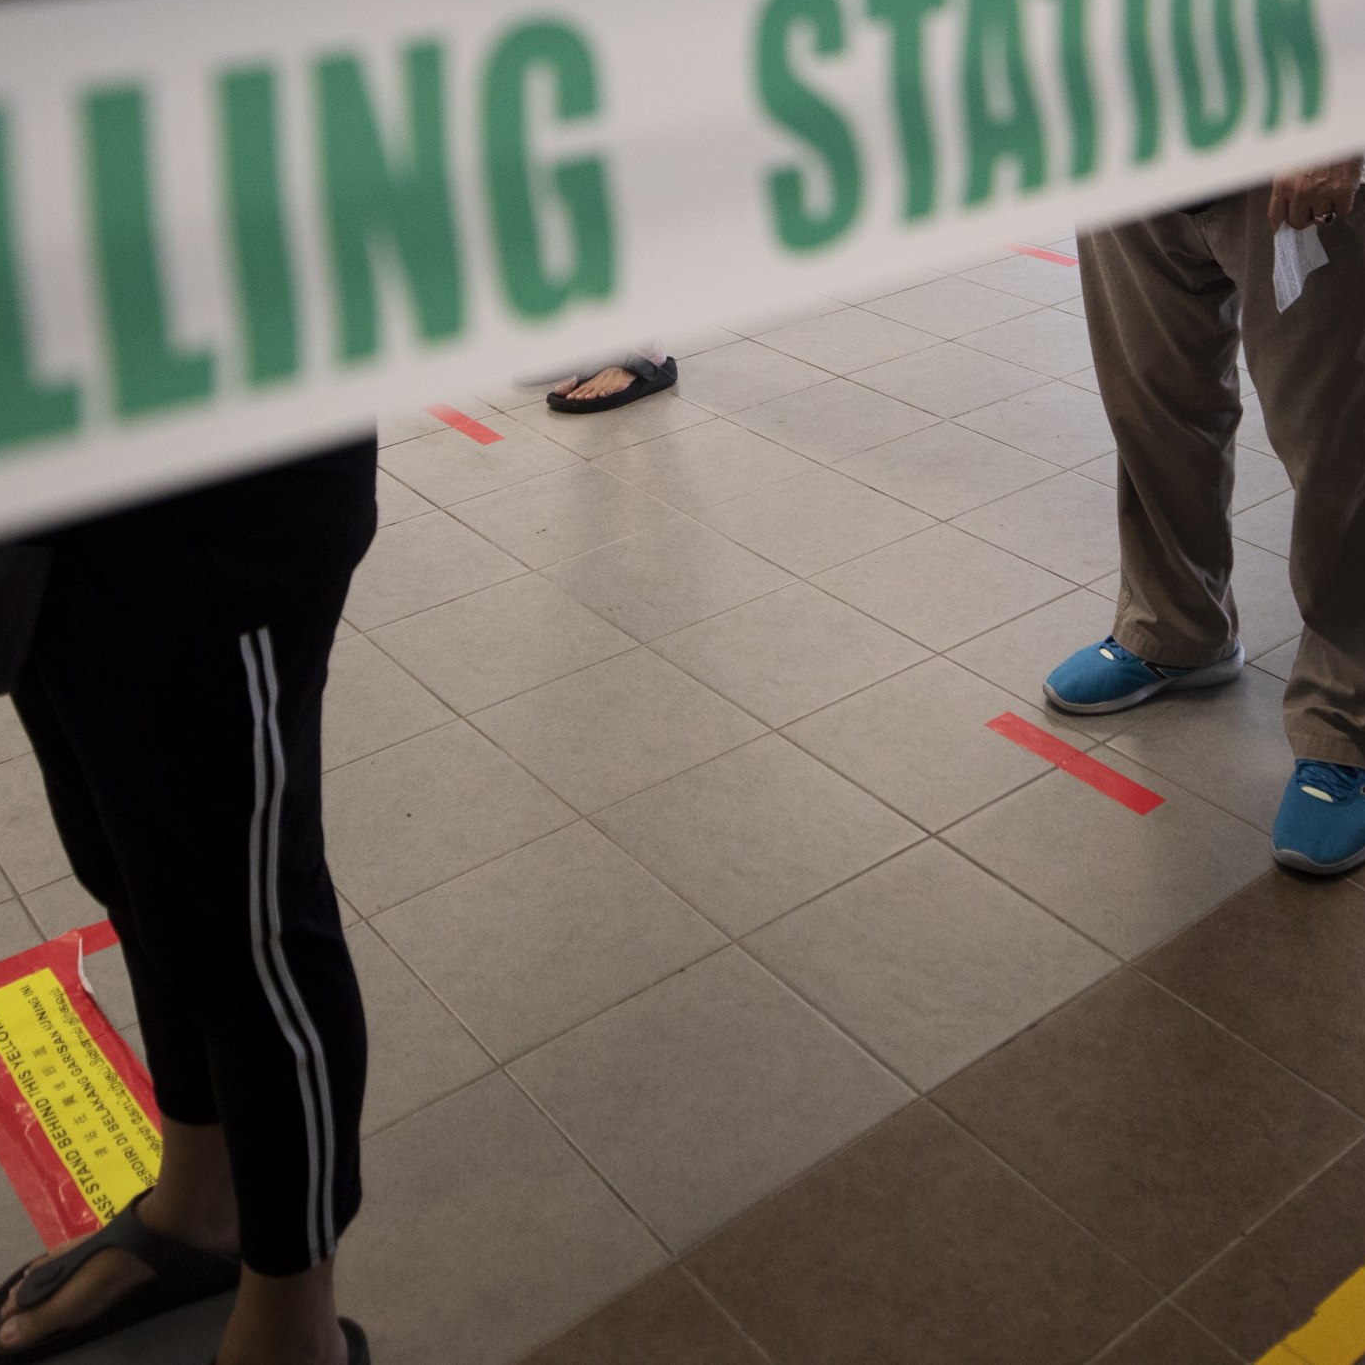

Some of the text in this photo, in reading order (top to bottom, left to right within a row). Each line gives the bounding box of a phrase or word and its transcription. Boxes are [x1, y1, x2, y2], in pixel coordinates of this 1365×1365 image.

[19, 984, 34, 999] INI
[27, 995, 55, 1033] KUNING
[48, 1029, 83, 1078] GARISAN
[16, 1068, 43, 1099] THIS
[77, 1075, 120, 1133] BELAKANG
[33, 1096, 74, 1150] BEHIND
[113, 1132, 129, 1147] DI
[64, 1147, 101, 1196] STAND
